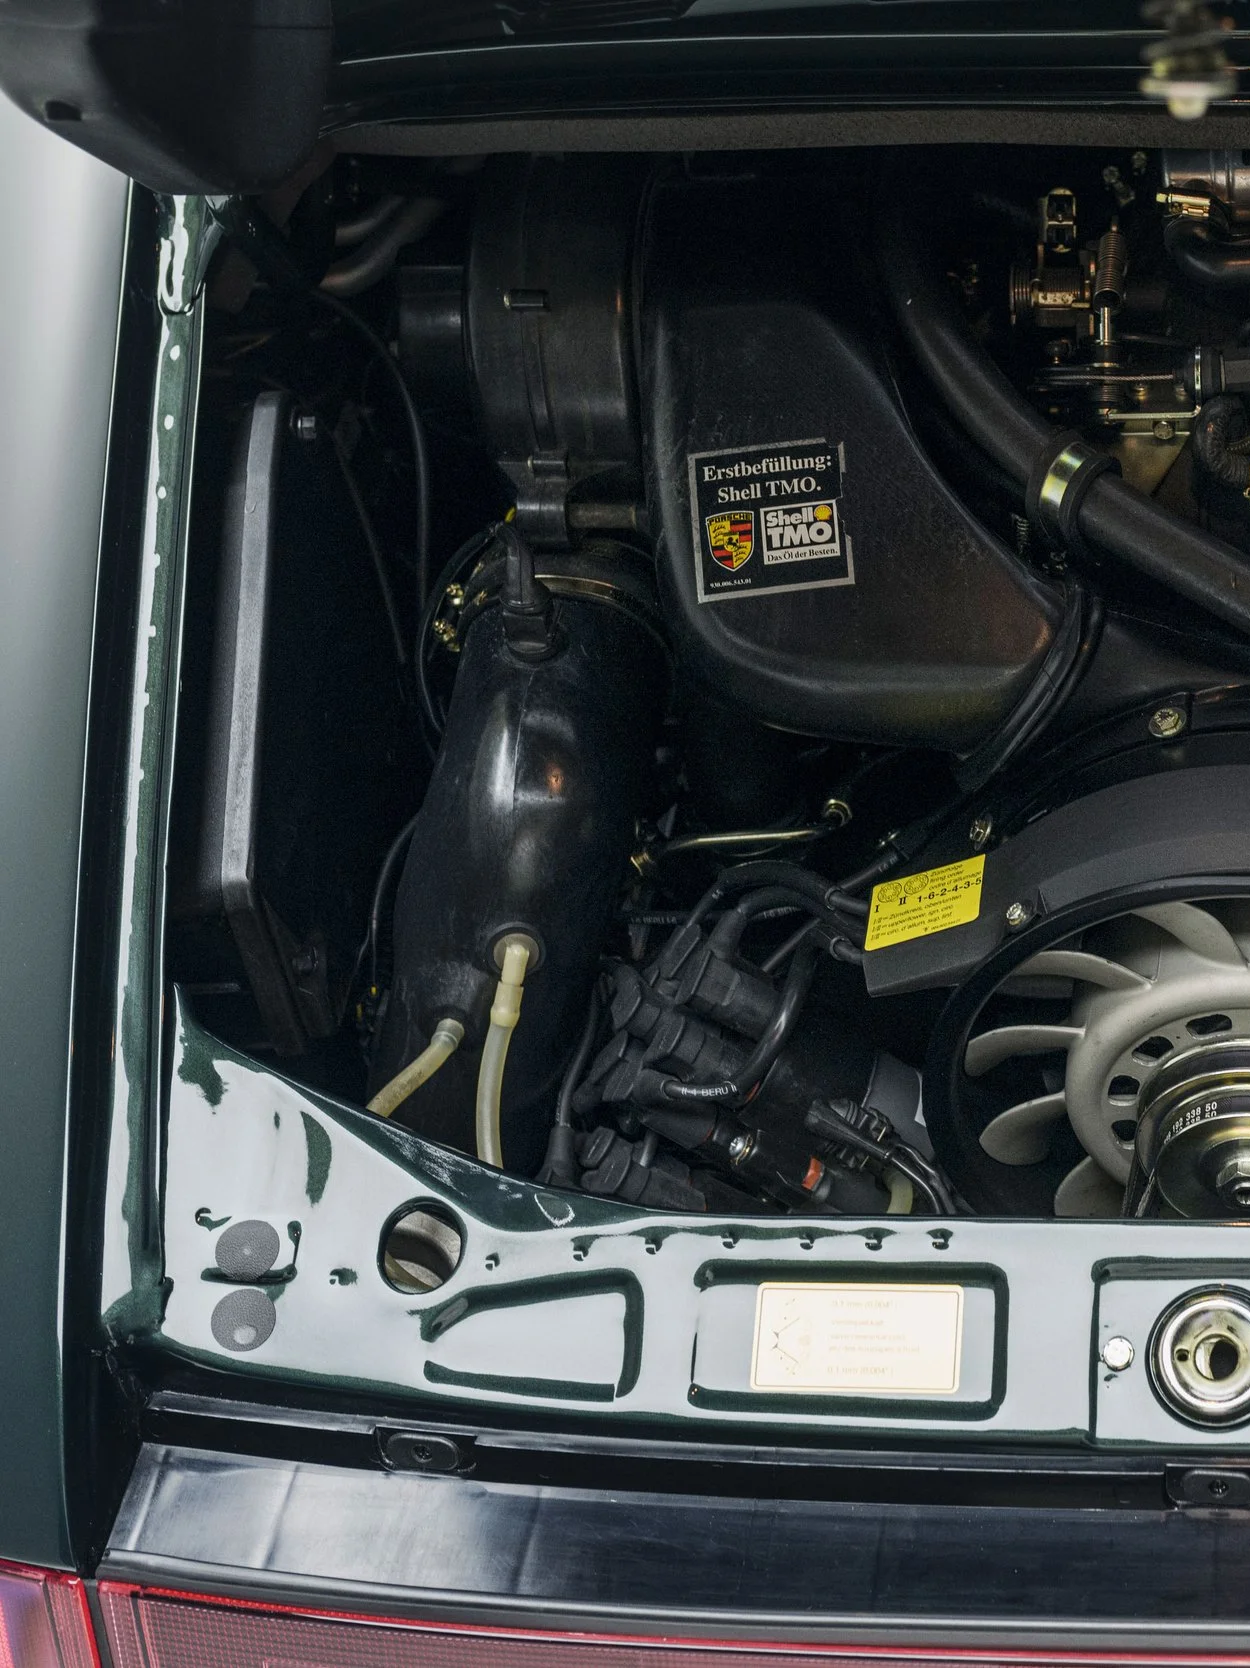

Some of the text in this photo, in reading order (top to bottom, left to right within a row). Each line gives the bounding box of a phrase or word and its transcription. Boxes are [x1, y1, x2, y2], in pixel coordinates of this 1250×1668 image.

[703, 455, 832, 482] Erstbefüllung:
[717, 476, 821, 503] Shell TMO.
[708, 511, 753, 526] PORSCHE
[766, 506, 814, 527] Shell
[767, 522, 832, 549] TMO
[767, 548, 839, 562] Das Öl der Besten.
[947, 870, 965, 879] order
[917, 879, 981, 903] 1-6-2-4-3-5
[874, 905, 879, 914] I
[898, 896, 907, 906] II
[702, 1086, 729, 1097] BERU
[1186, 1107, 1201, 1121] 338
[1205, 1101, 1217, 1112] 50
